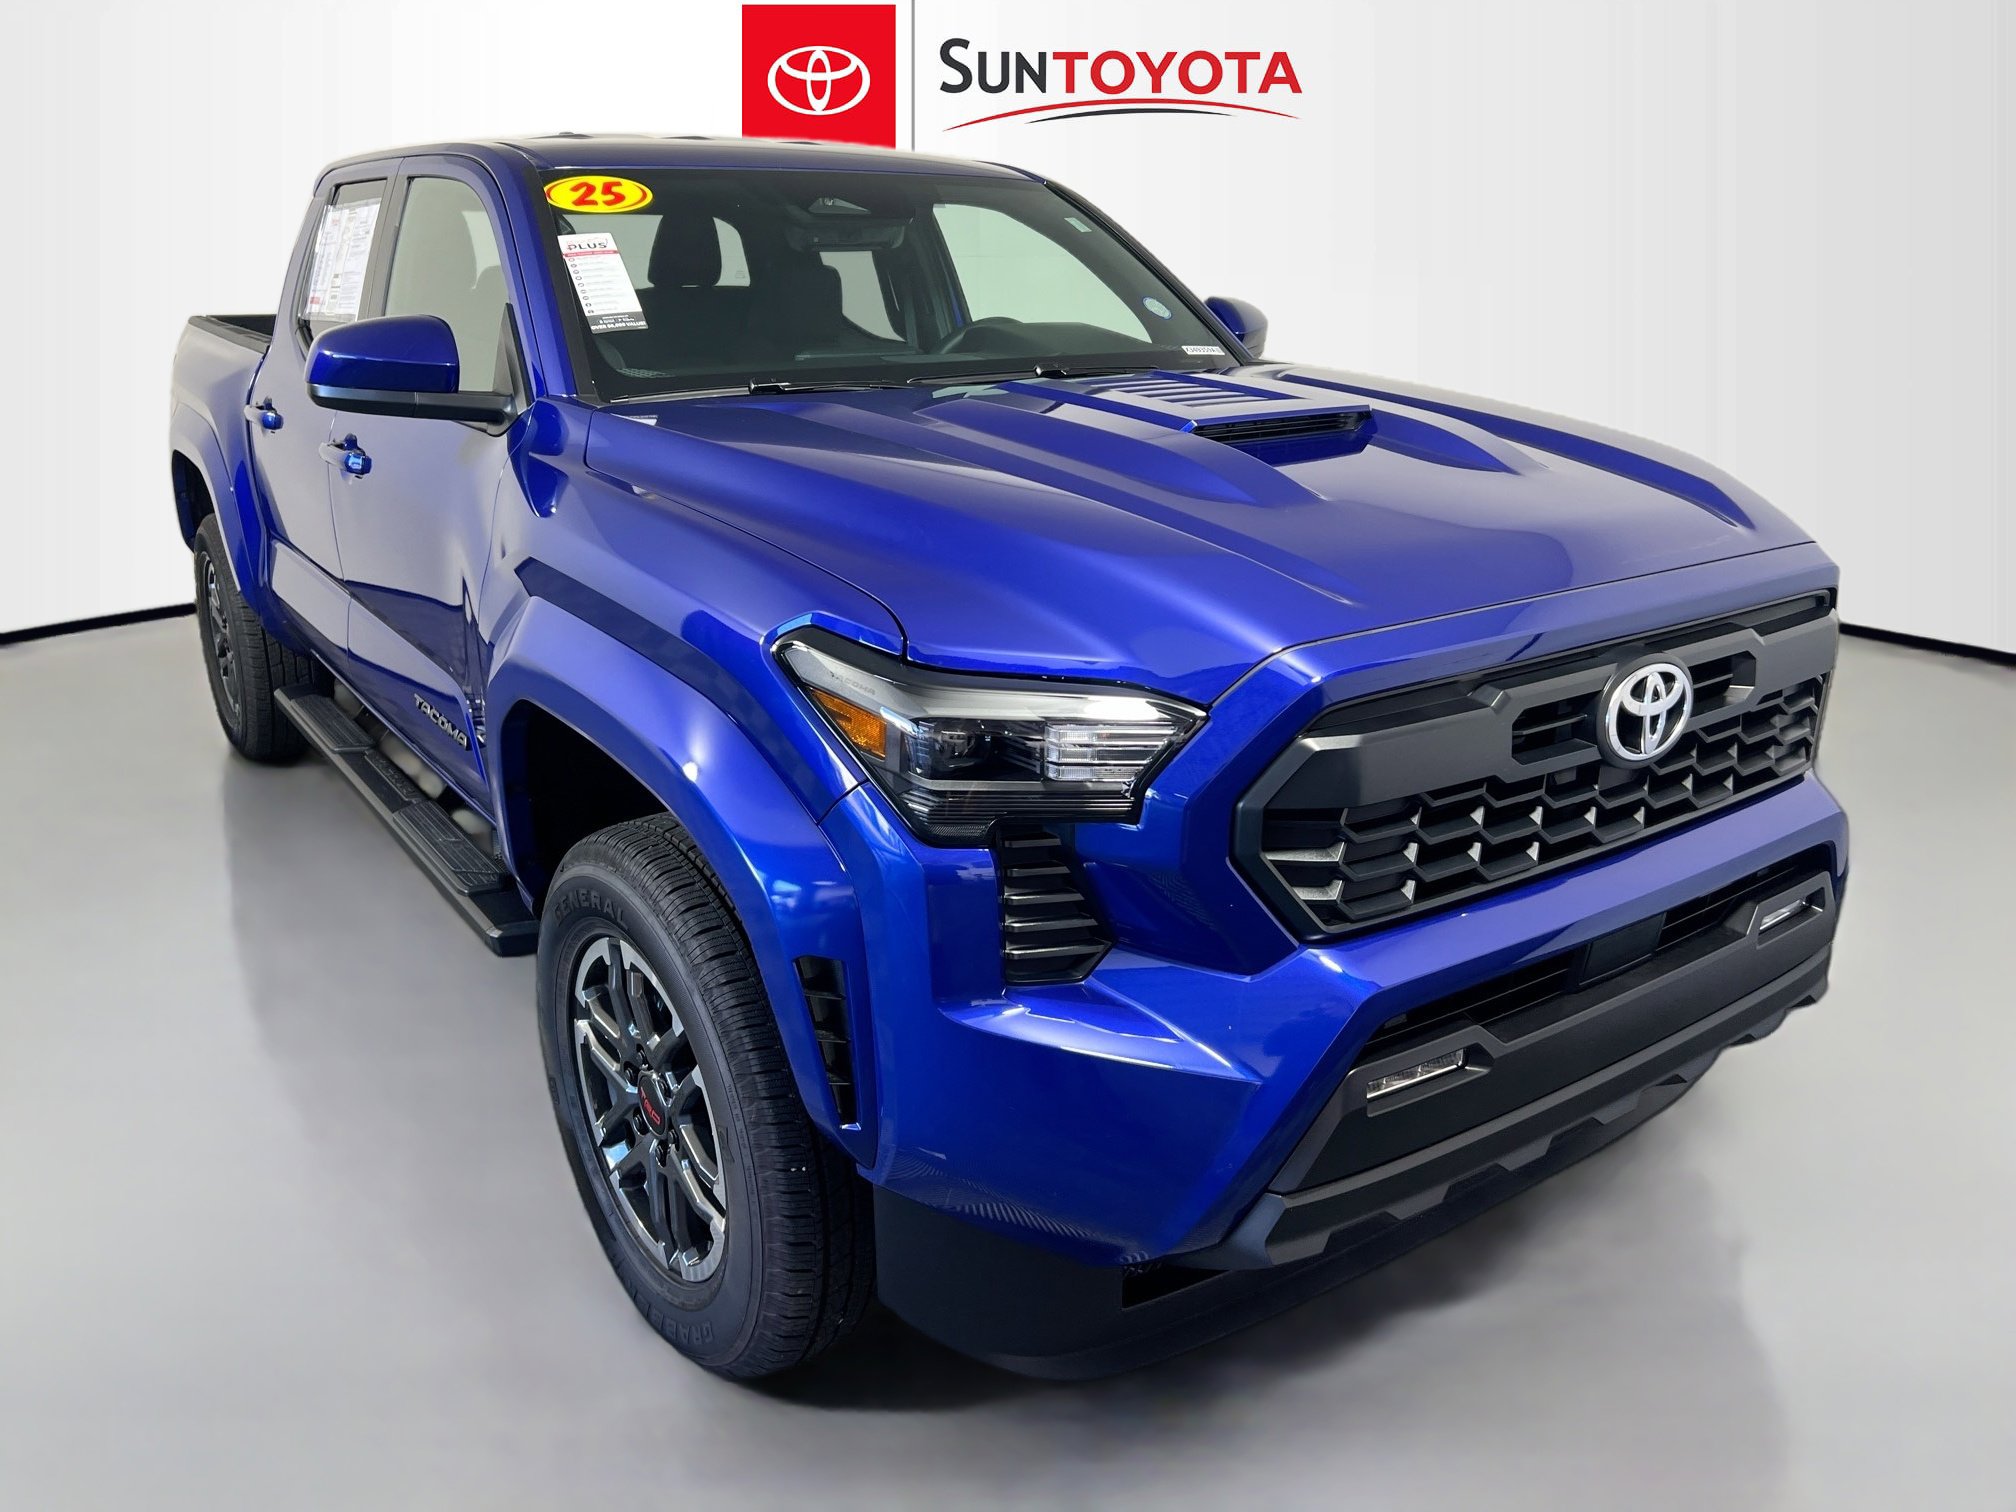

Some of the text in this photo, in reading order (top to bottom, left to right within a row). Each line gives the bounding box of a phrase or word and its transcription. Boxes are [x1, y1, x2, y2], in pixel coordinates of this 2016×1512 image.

[569, 181, 626, 207] 25
[413, 693, 468, 749] TACOMA
[554, 888, 630, 931] GENERAL
[640, 1086, 661, 1126] TRD
